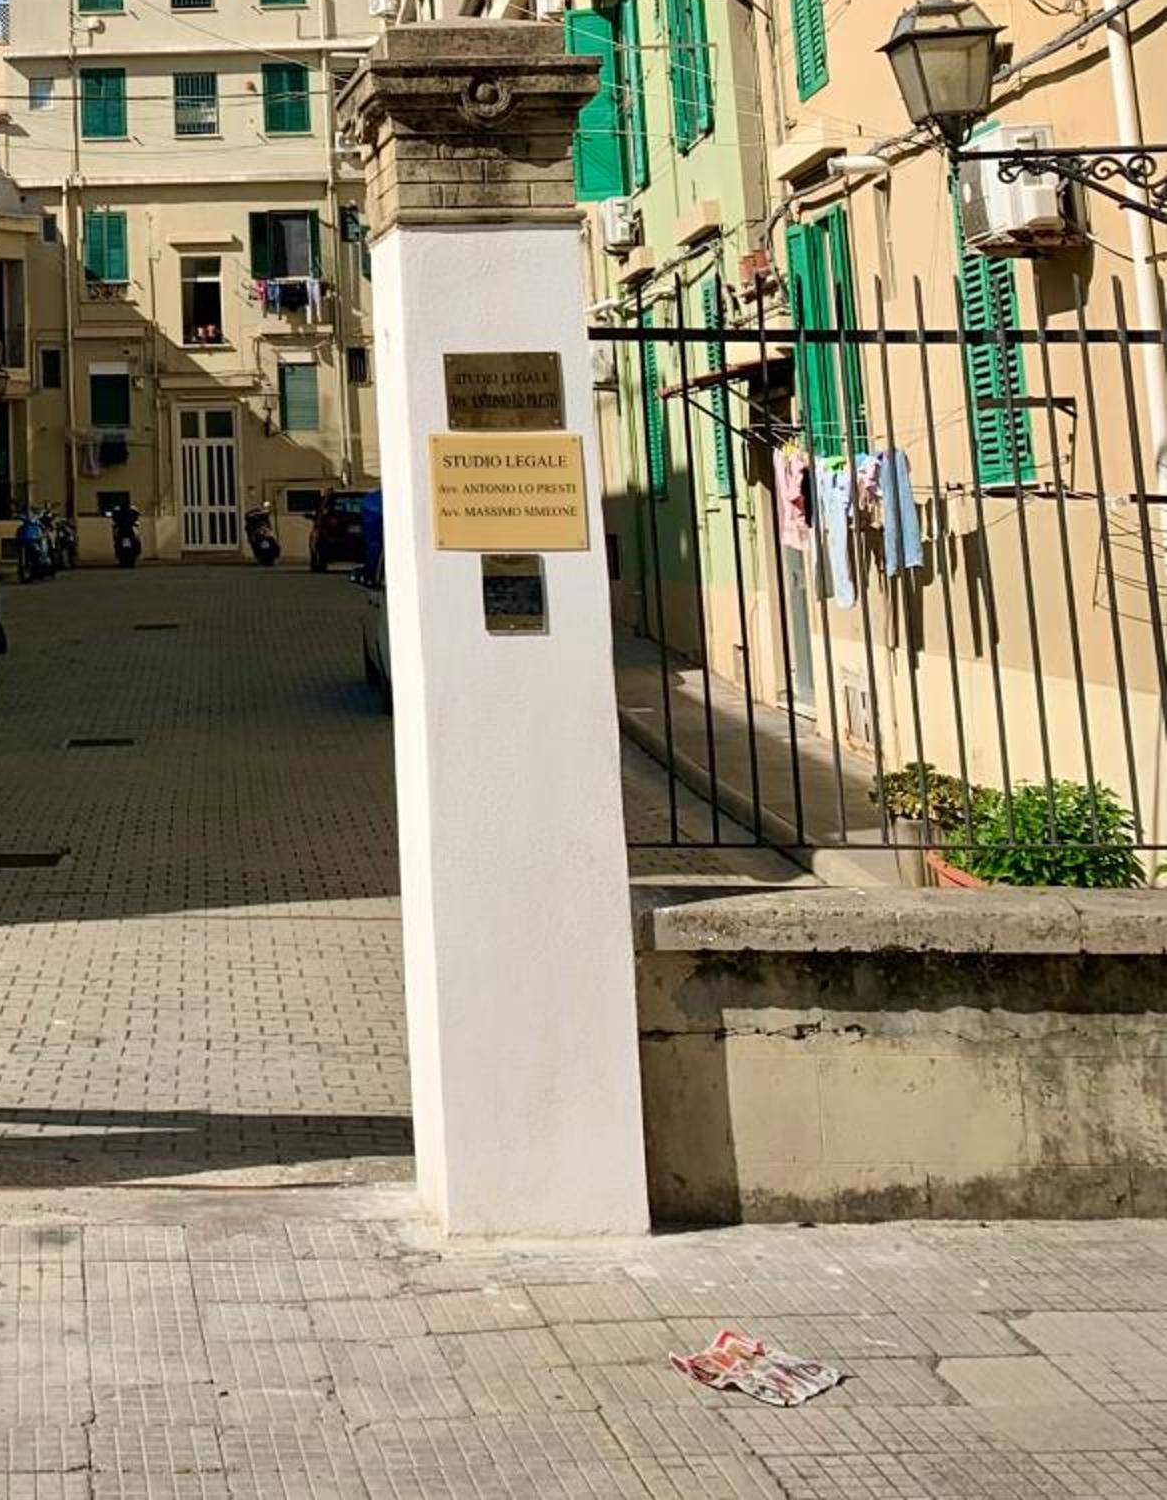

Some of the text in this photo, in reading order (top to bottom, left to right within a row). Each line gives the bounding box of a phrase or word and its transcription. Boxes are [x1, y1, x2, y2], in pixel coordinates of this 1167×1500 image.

[442, 454, 568, 469] STUDIO LEGALE
[463, 483, 516, 495] ANTONIO
[518, 483, 535, 494] LO
[536, 483, 577, 494] PRESTI
[464, 506, 522, 517] MASSIMO
[524, 506, 578, 517] SIMEONE
